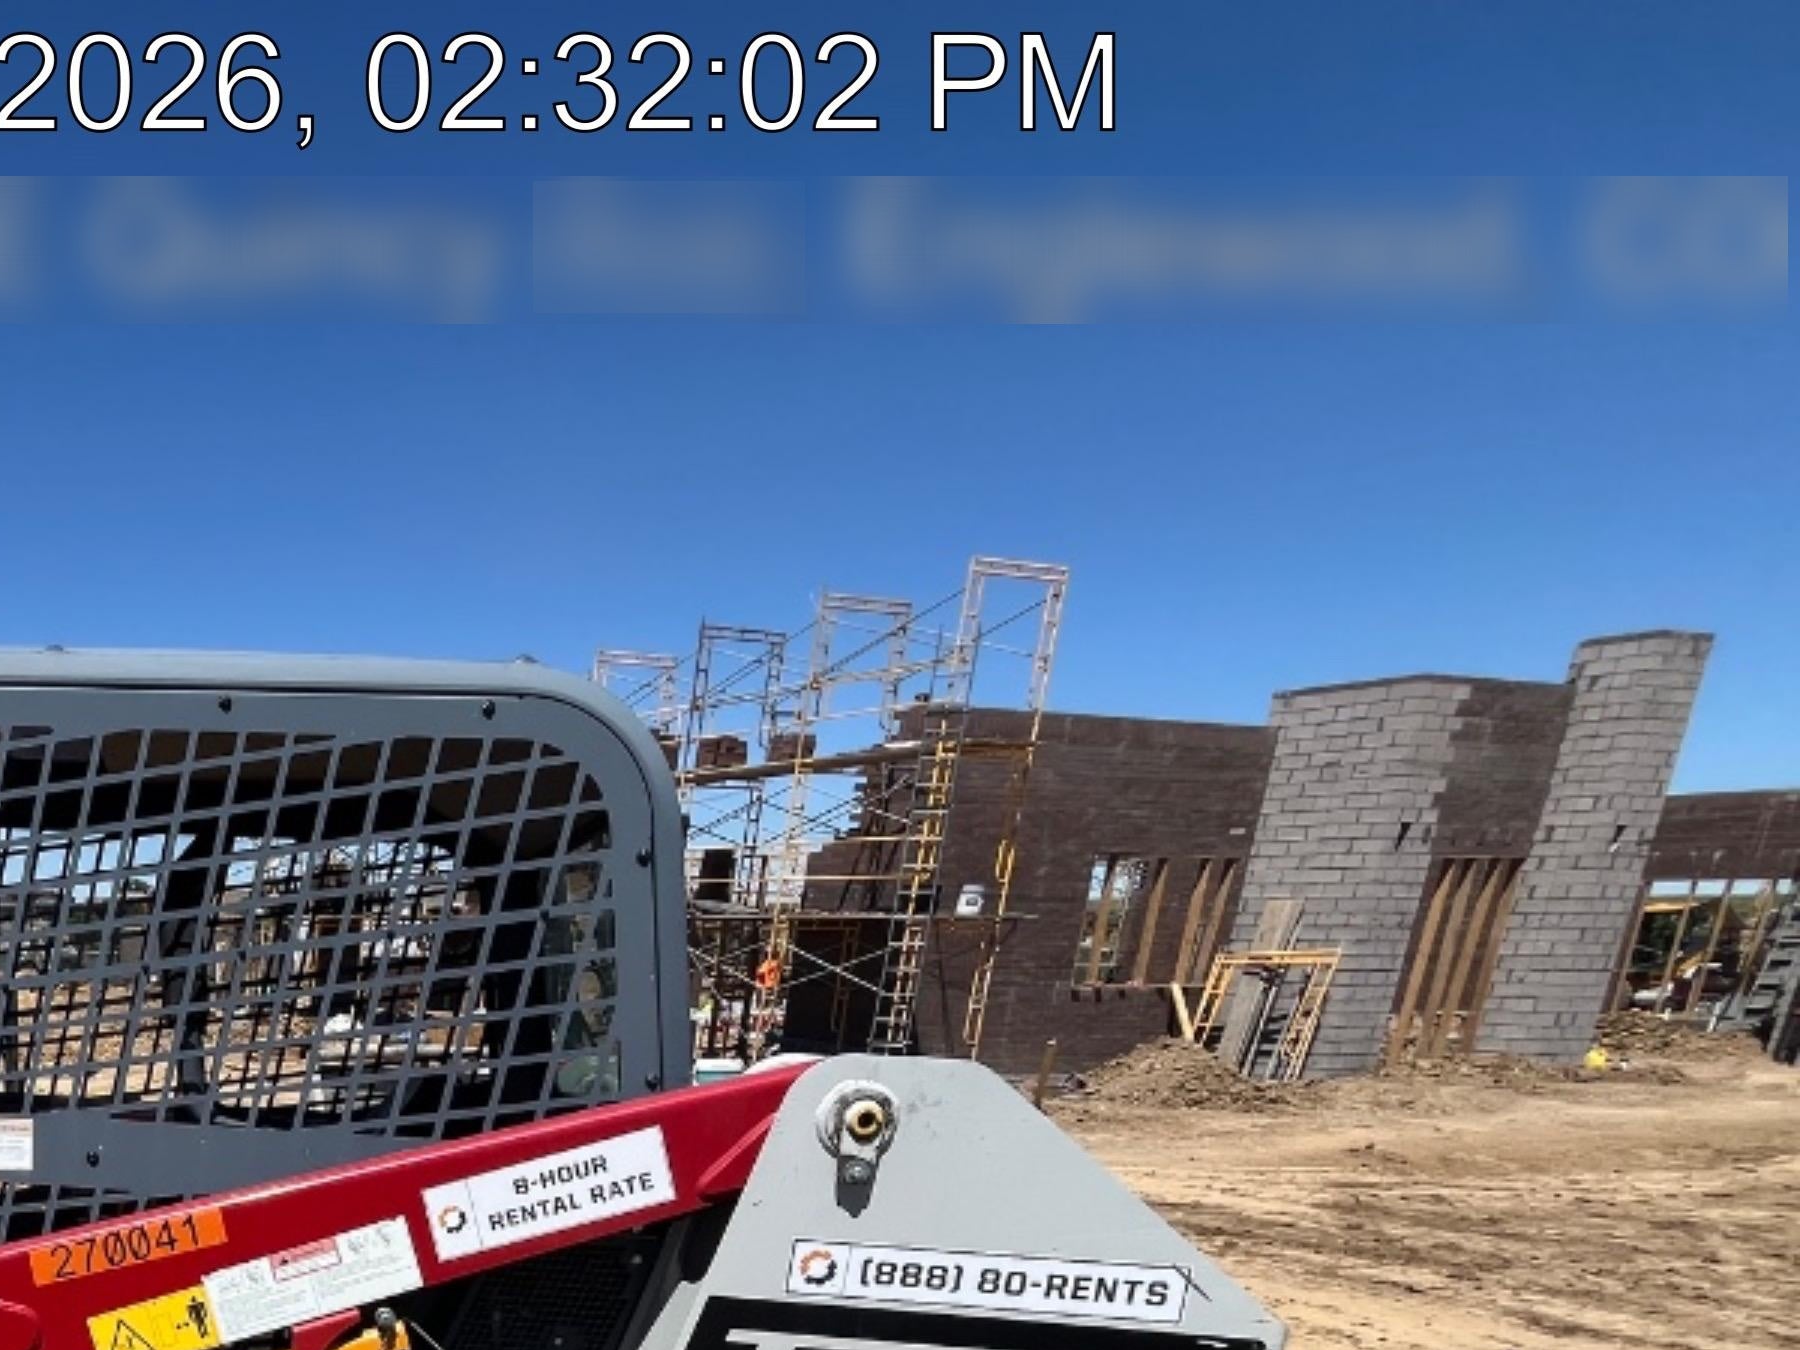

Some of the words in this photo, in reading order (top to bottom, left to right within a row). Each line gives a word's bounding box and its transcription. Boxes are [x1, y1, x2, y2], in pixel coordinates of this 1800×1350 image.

[488, 1193, 583, 1231] RENTAL
[590, 1172, 655, 1205] RATE
[512, 1154, 609, 1196] 8-HOUR
[51, 1214, 200, 1278] 270041
[859, 1258, 964, 1294] (888)
[977, 1270, 1171, 1307] 80-RENTS
